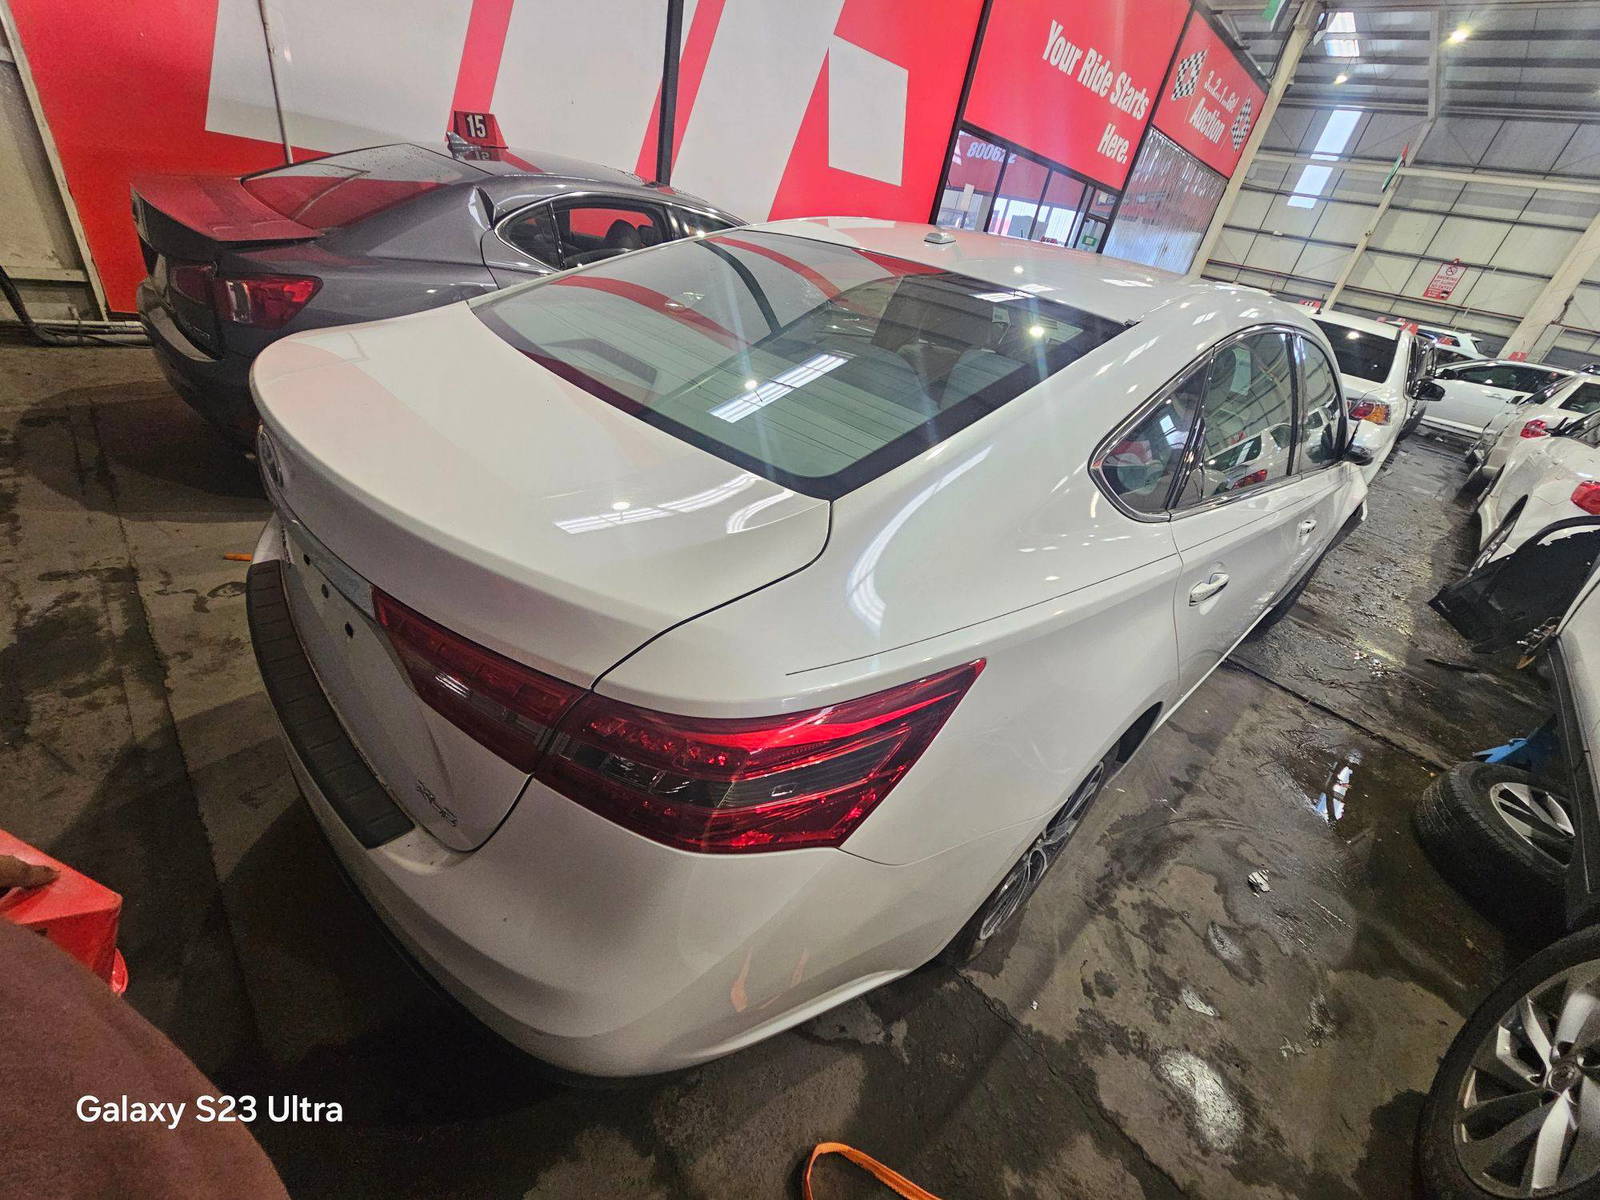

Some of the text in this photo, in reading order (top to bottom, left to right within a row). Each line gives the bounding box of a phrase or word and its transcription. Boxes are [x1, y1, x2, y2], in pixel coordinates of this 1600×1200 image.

[1042, 18, 1150, 121] Your Ride Starts
[466, 114, 487, 138] 15
[1189, 96, 1226, 144] Auction
[1096, 122, 1130, 164] Here.
